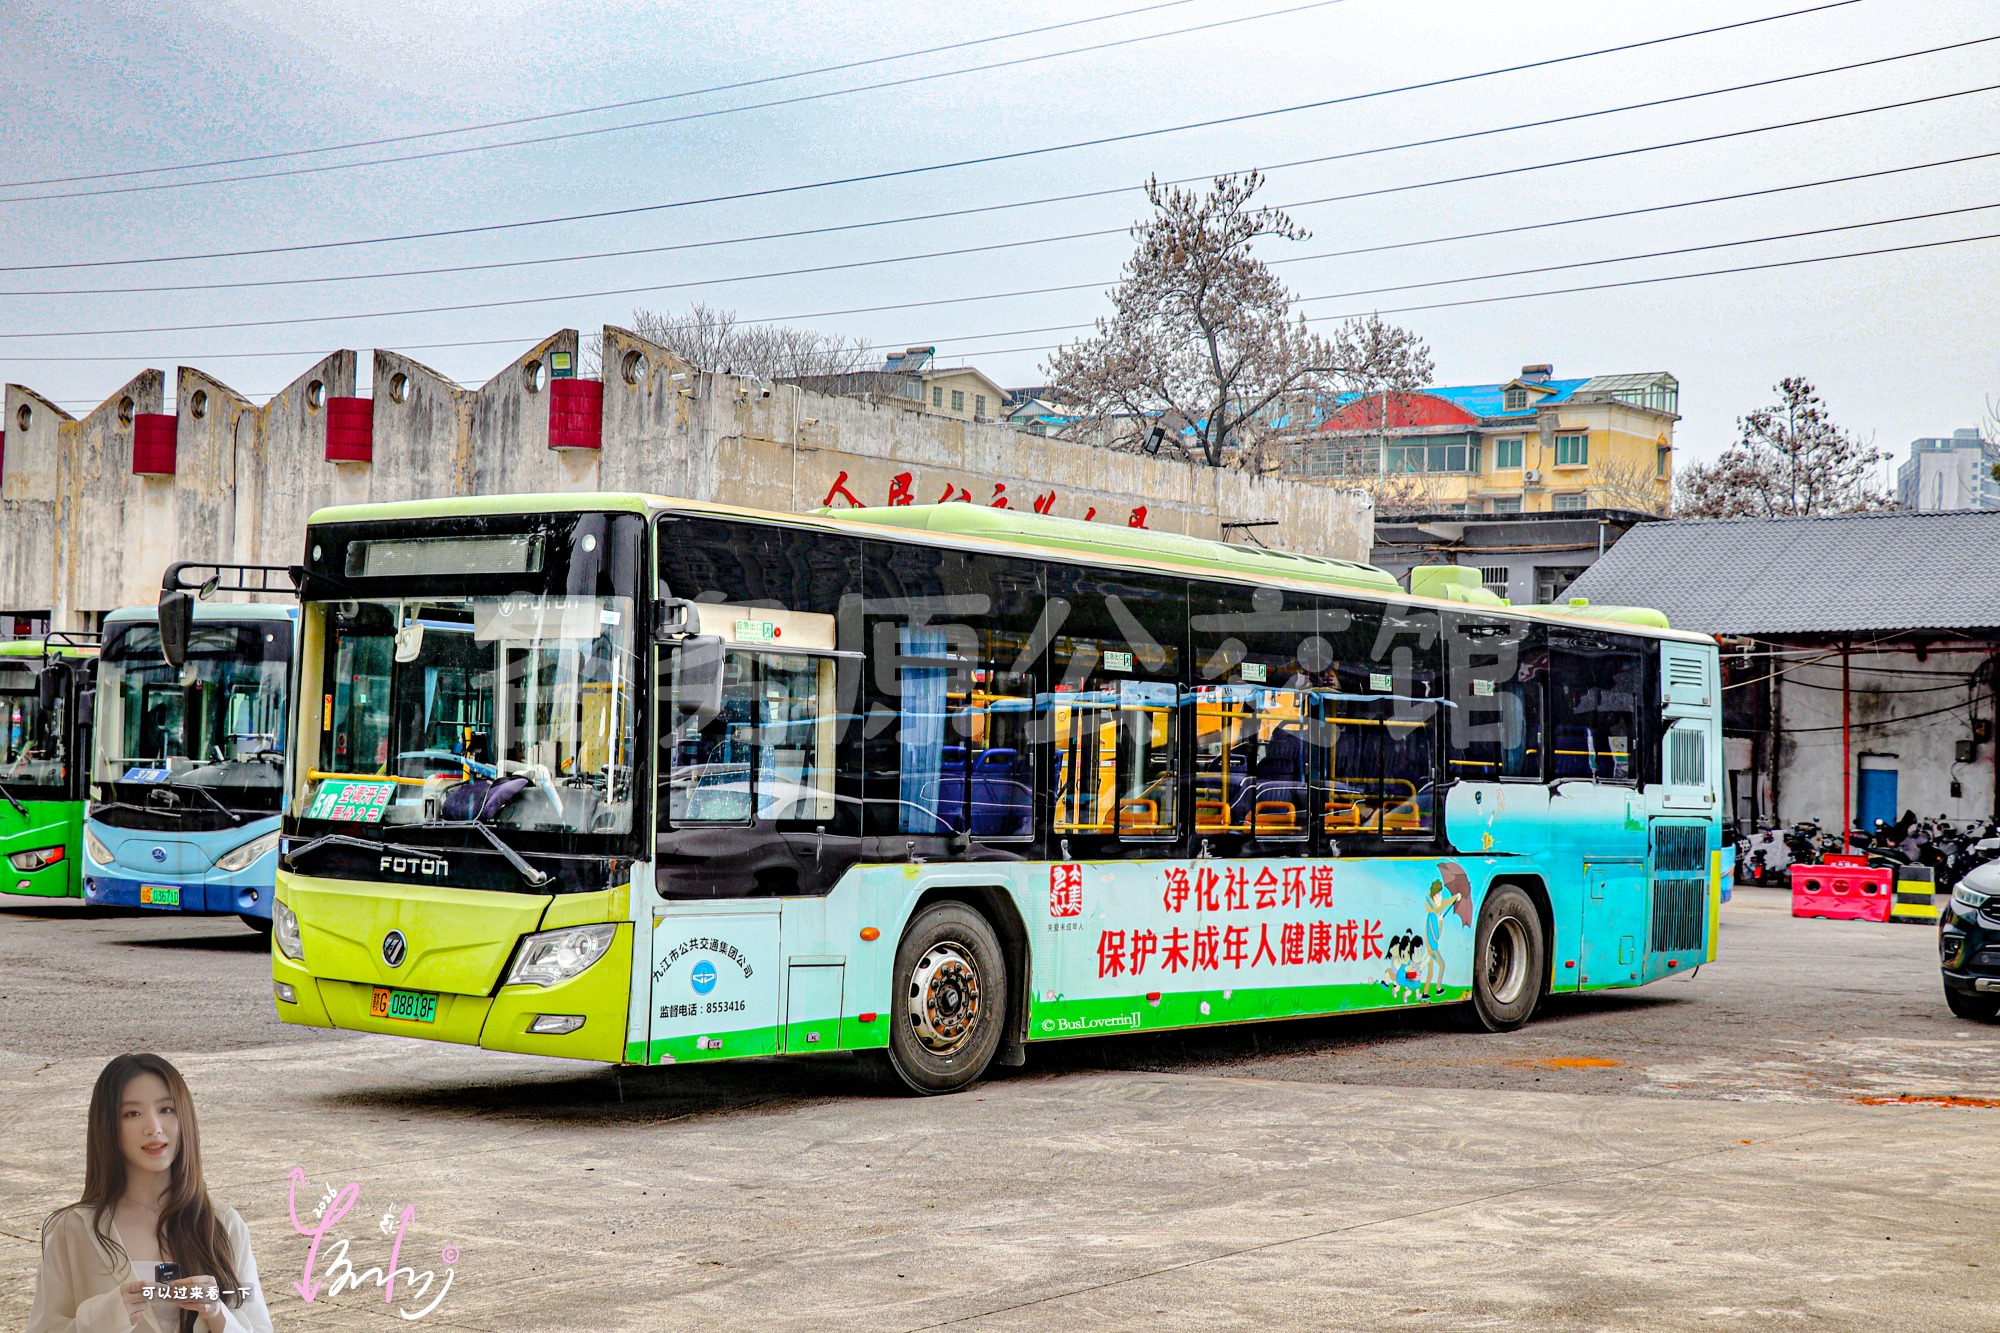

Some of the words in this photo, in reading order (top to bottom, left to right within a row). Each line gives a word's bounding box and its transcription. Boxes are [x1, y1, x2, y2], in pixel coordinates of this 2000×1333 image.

[338, 785, 390, 805] 空调开启
[380, 856, 448, 876] FOTON
[1163, 865, 1334, 913] 净化社会环境
[652, 937, 754, 982] 九江市公共交通集团公司
[1096, 919, 1384, 979] 保护未成年人健康成长
